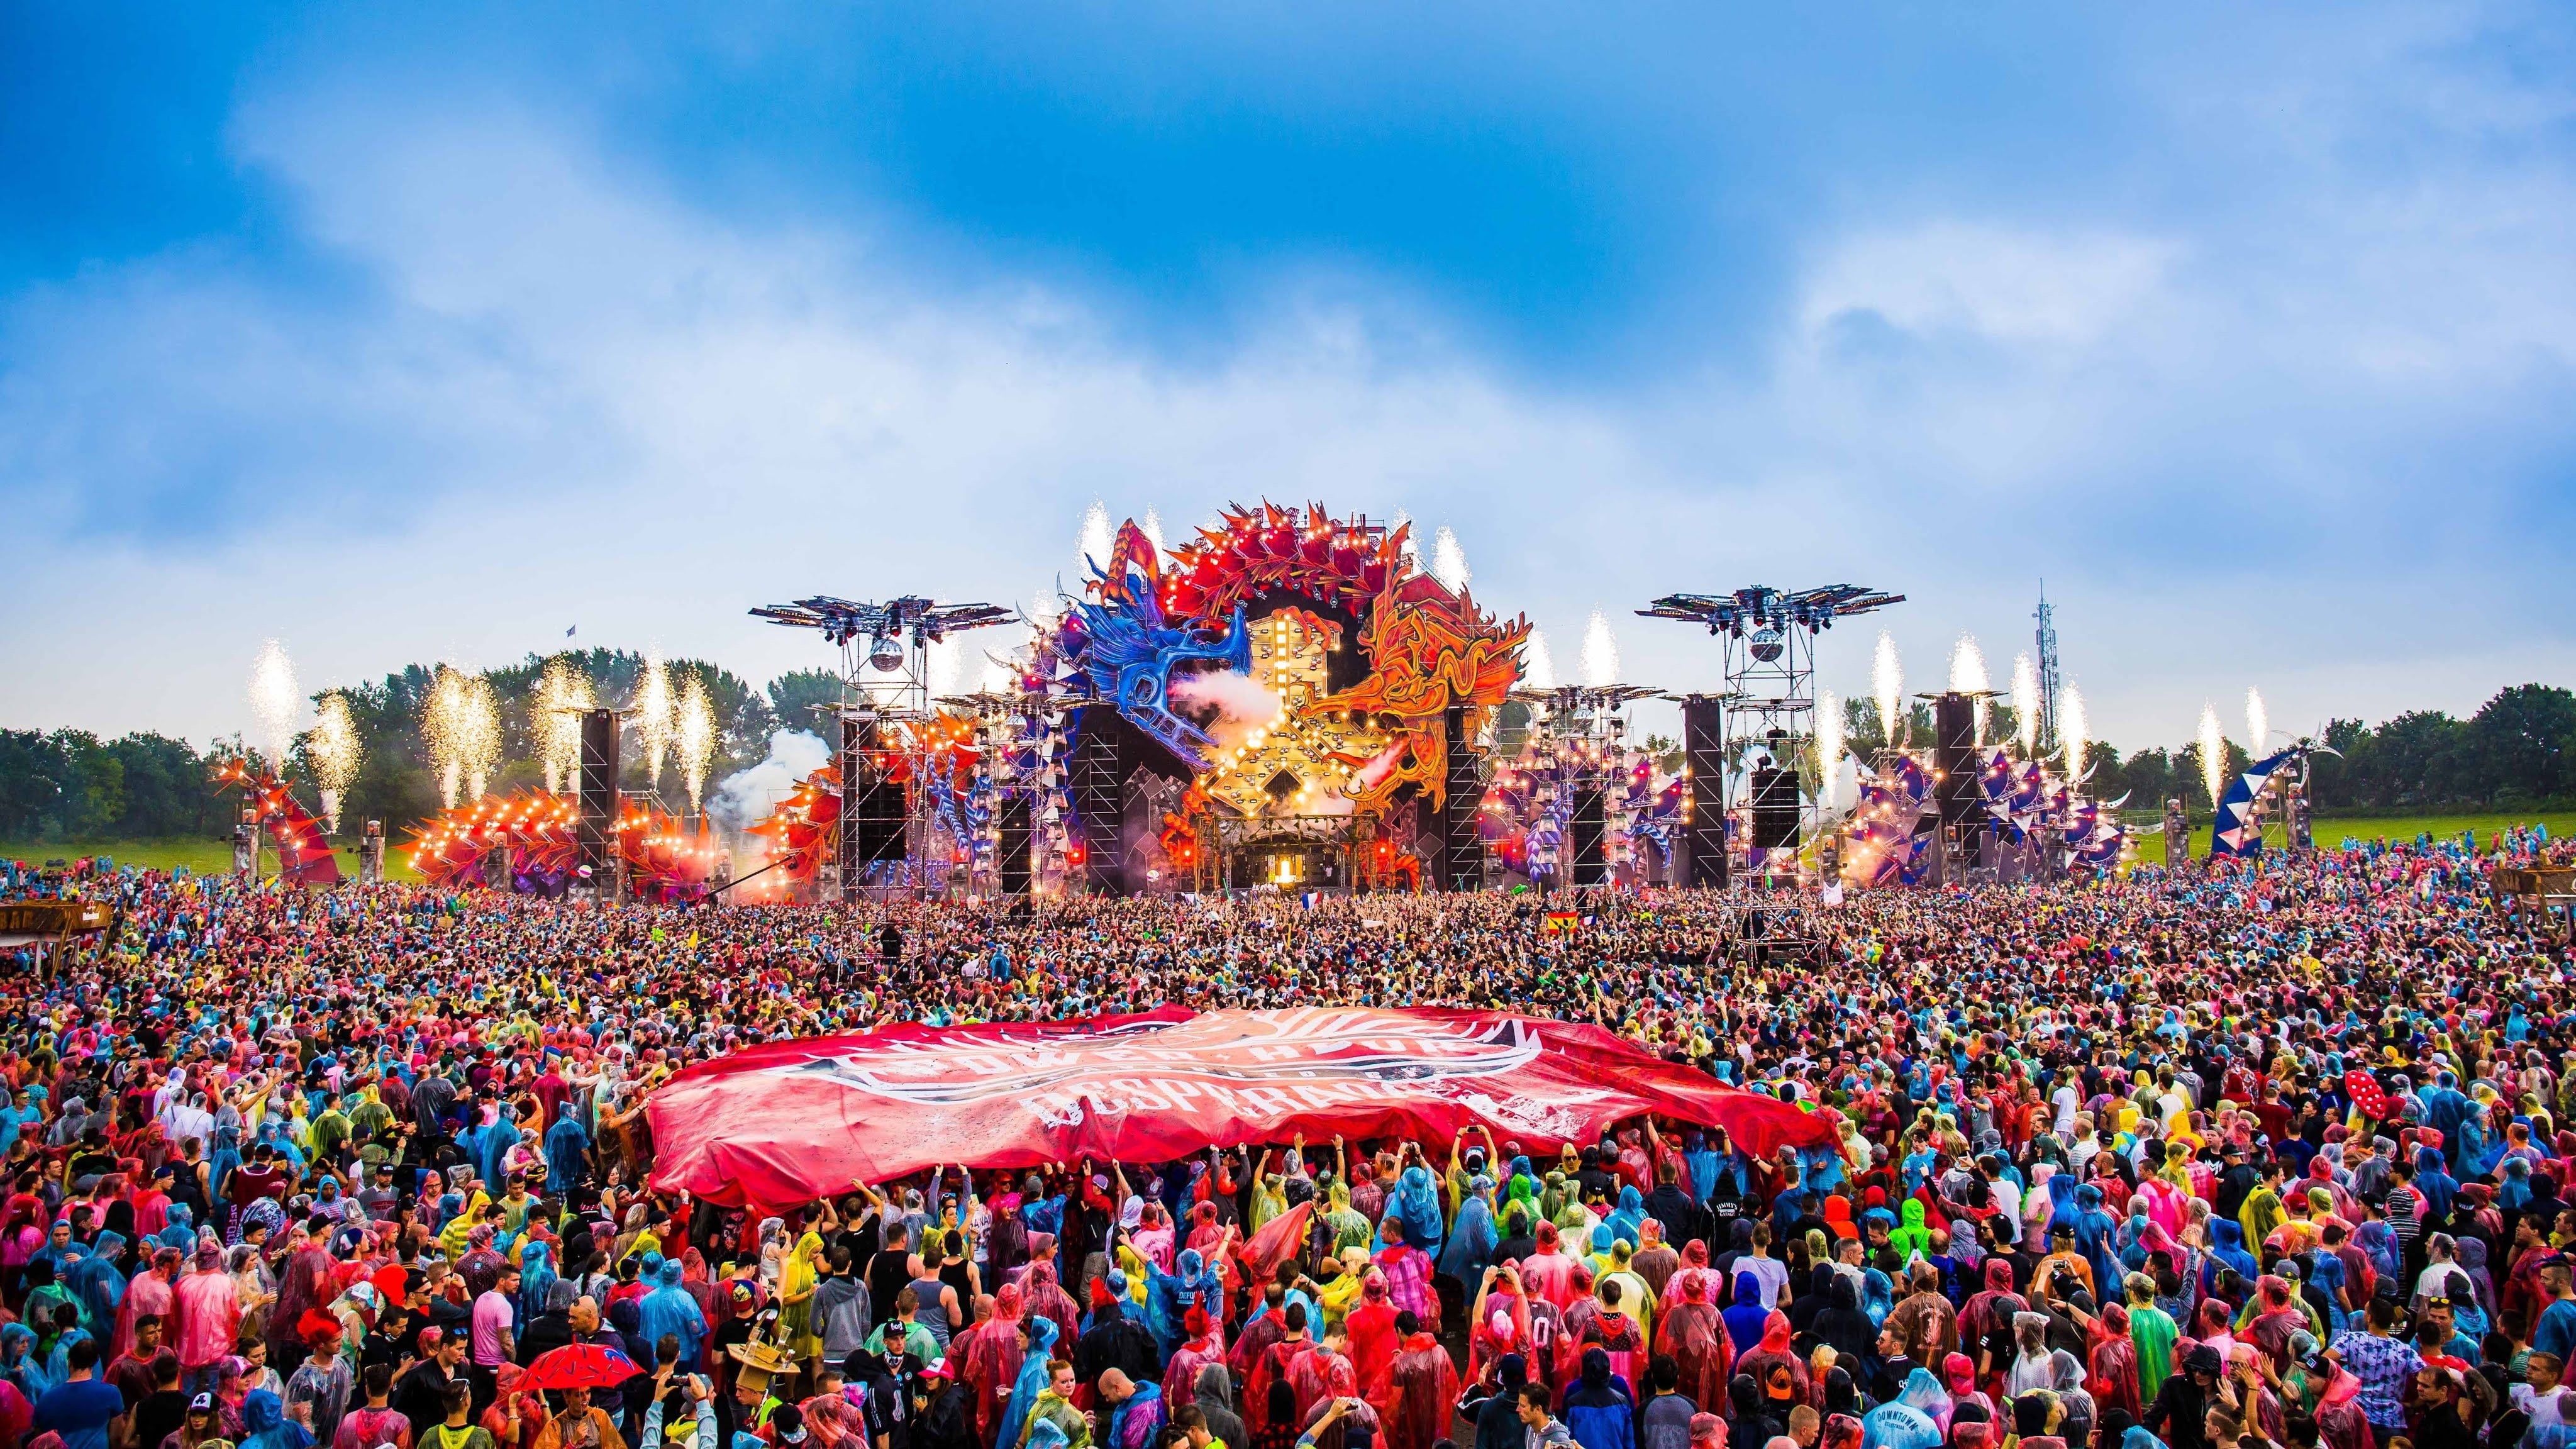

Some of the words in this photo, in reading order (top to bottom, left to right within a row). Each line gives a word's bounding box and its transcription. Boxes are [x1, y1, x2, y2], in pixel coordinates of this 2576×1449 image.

[1250, 1040, 1460, 1062] HOUR
[1716, 1202, 1738, 1212] JIMMY'S
[1877, 1410, 1919, 1431] DOWNTOWN
